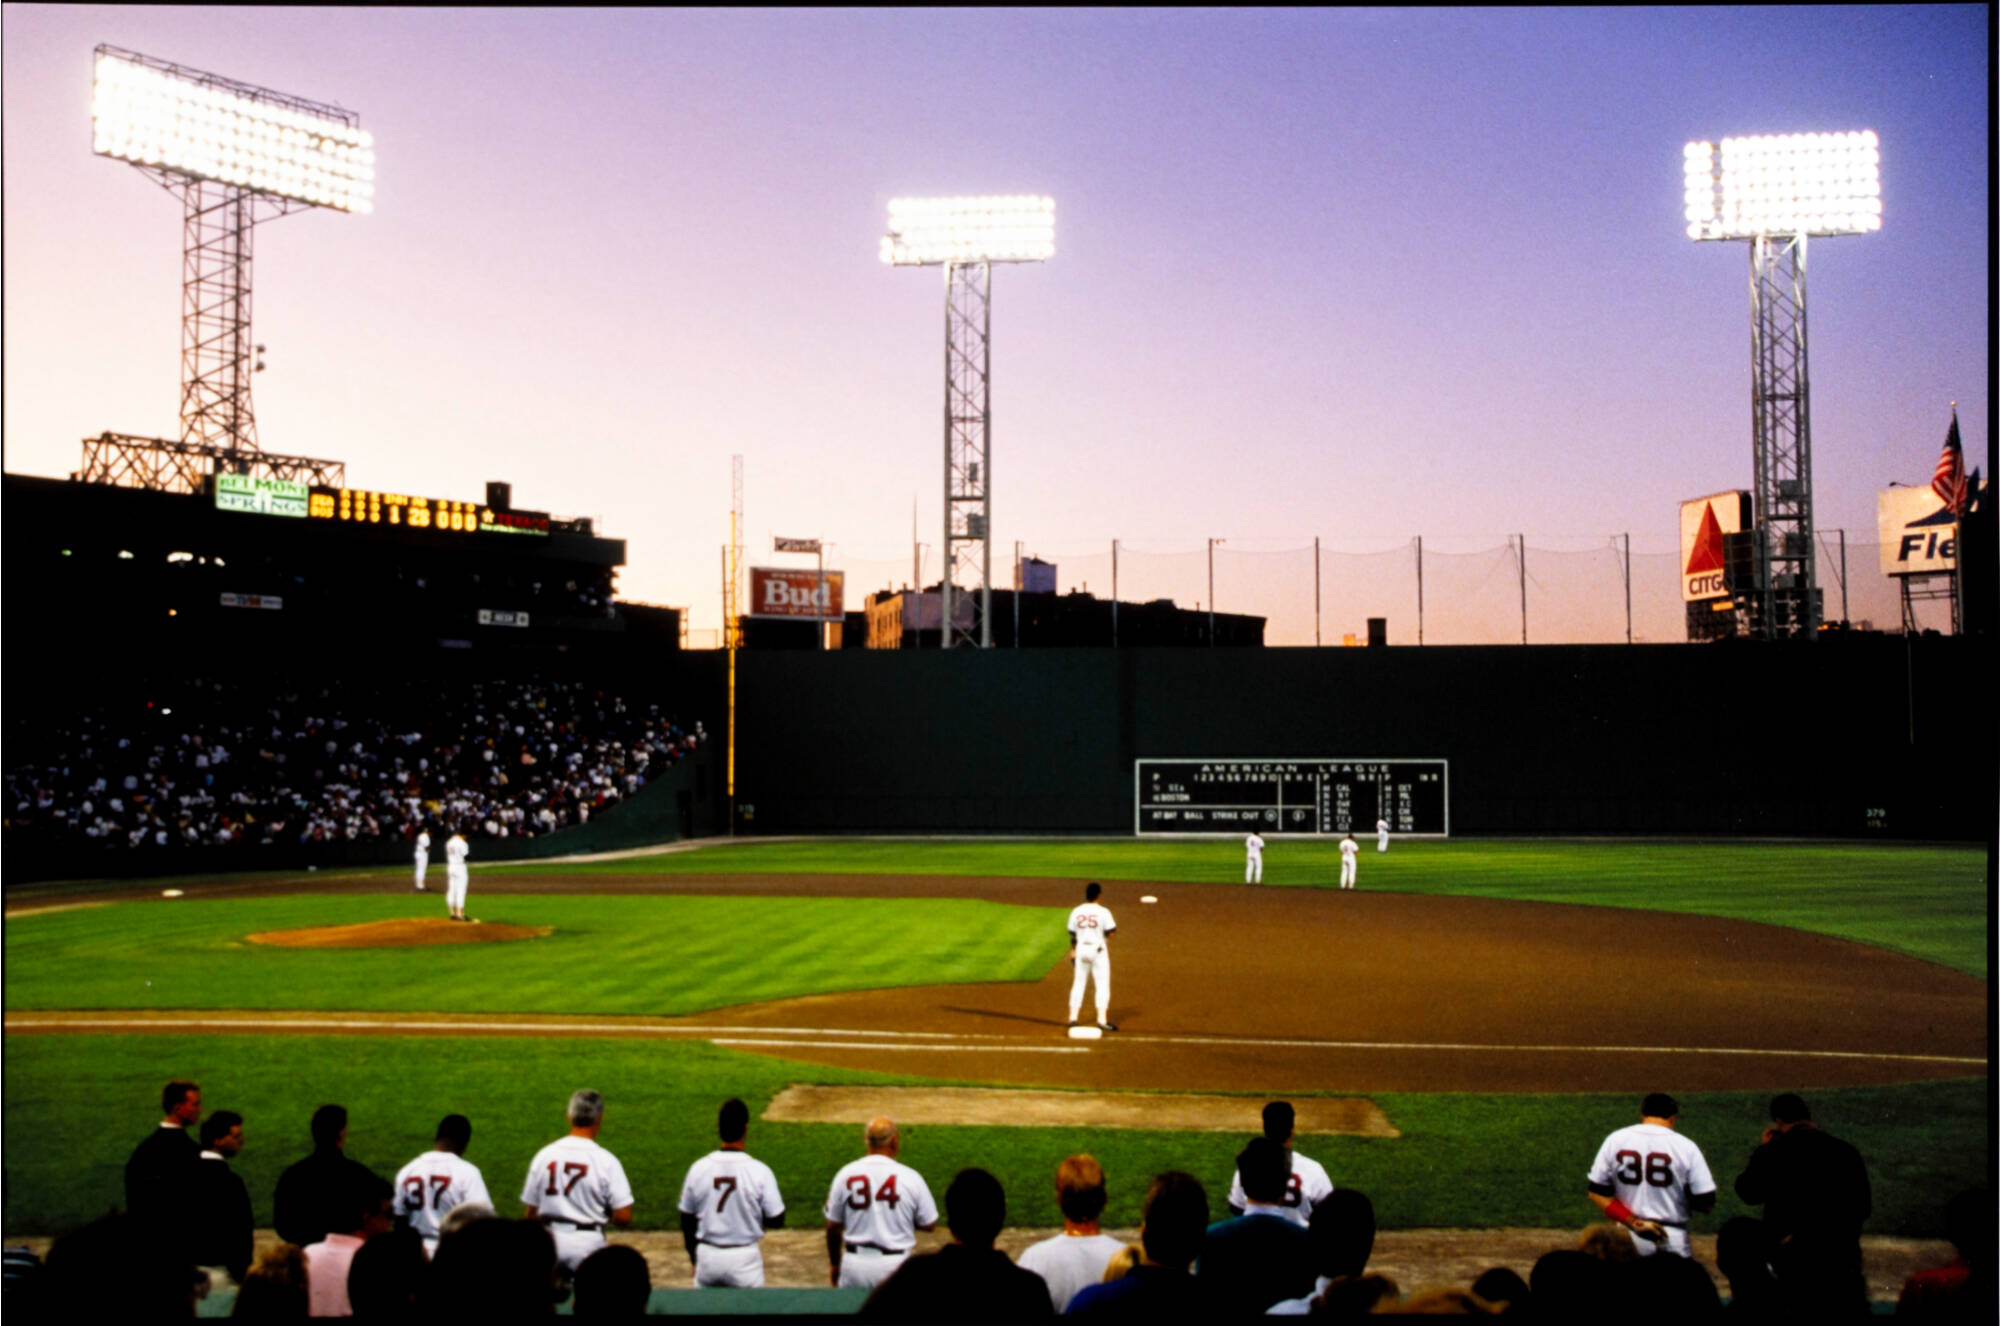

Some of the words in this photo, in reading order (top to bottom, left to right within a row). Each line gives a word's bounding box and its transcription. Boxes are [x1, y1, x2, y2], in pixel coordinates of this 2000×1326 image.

[220, 477, 307, 494] BELMONT
[219, 496, 307, 514] SPRINGS
[390, 505, 400, 523] 1
[763, 579, 831, 607] Bud
[1201, 764, 1297, 773] AMERICAN
[1318, 764, 1389, 773] LEAGUE
[1184, 811, 1204, 820] BALL
[1211, 811, 1238, 820] STRIKE
[1241, 811, 1259, 820] OUT
[1076, 914, 1099, 929] 25
[545, 1160, 589, 1197] 17
[402, 1174, 452, 1211] 37
[713, 1176, 737, 1213] 7
[846, 1174, 900, 1210] 34
